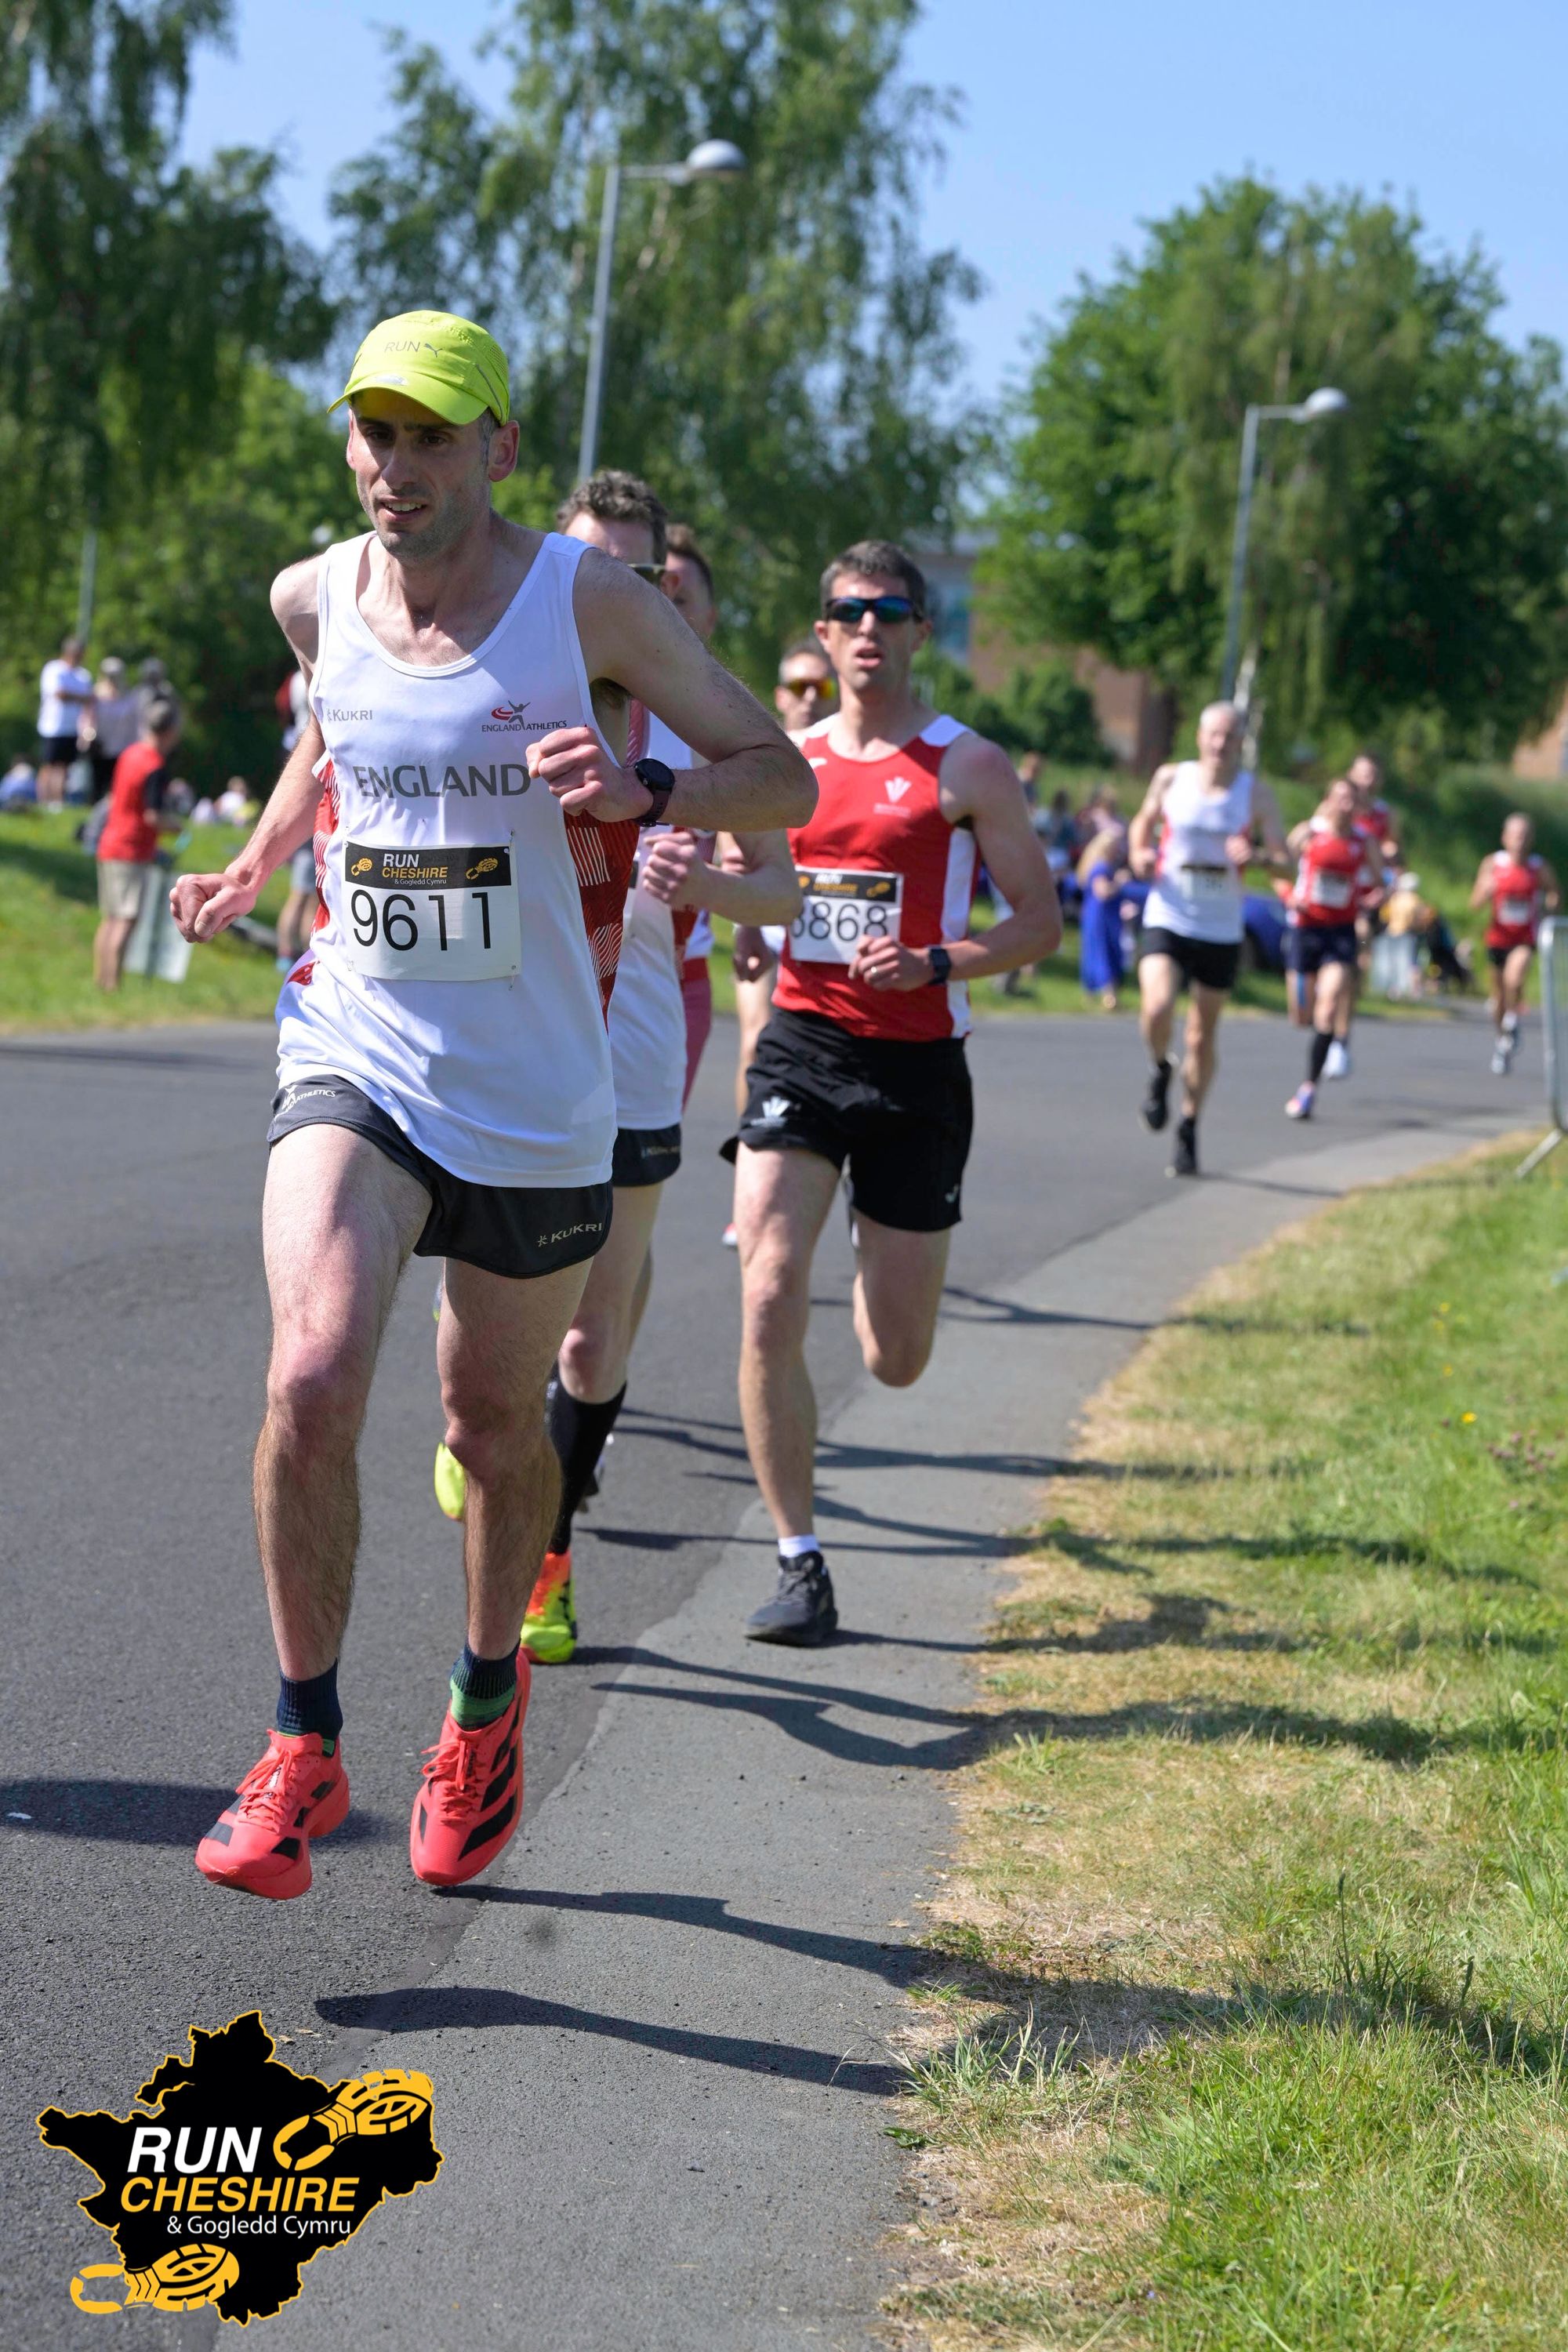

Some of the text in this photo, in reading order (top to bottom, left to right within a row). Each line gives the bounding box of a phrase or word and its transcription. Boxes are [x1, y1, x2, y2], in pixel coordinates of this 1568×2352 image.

[384, 341, 420, 353] RUN
[332, 709, 373, 721] KUKRI
[481, 720, 568, 732] ENGLAND ATHLETICS
[353, 764, 532, 798] ENGLAND
[383, 853, 419, 868] RUN
[382, 866, 448, 879] CHESHIRE
[350, 889, 492, 951] 9611
[296, 1089, 336, 1101] ATHLETICS
[551, 1222, 603, 1243] KUKRI
